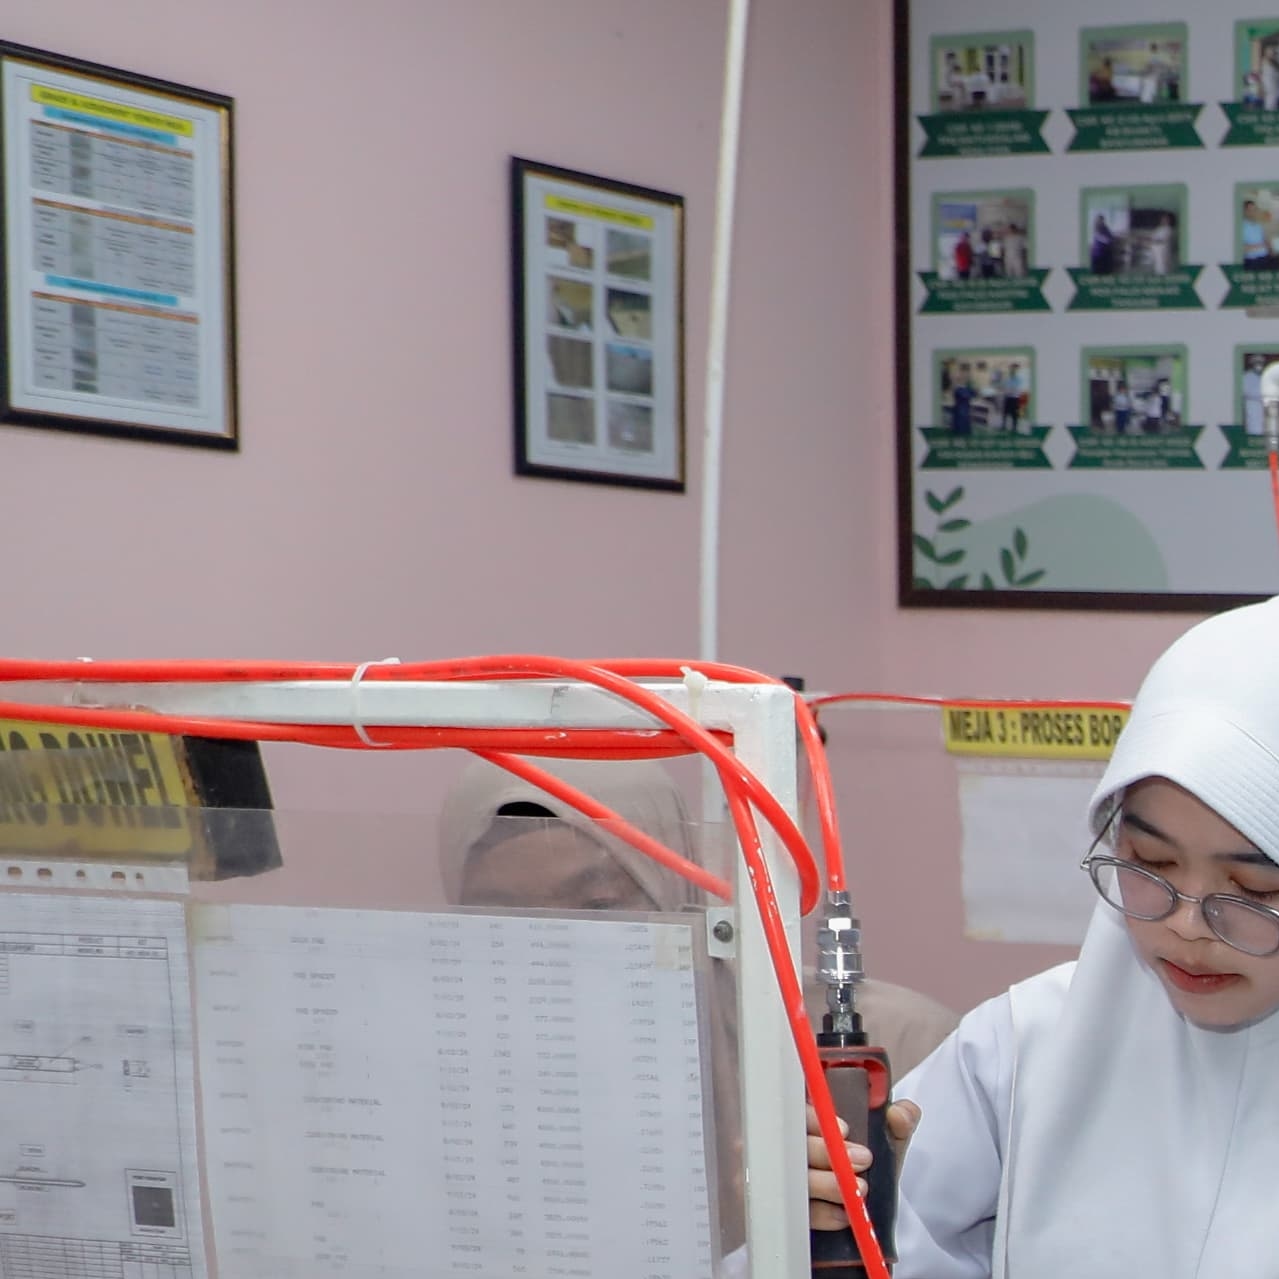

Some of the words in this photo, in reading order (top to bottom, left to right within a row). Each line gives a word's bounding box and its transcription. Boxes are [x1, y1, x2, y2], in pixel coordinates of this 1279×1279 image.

[949, 710, 994, 743] MEJA
[997, 711, 1008, 744] 3
[1019, 712, 1085, 746] PROSES
